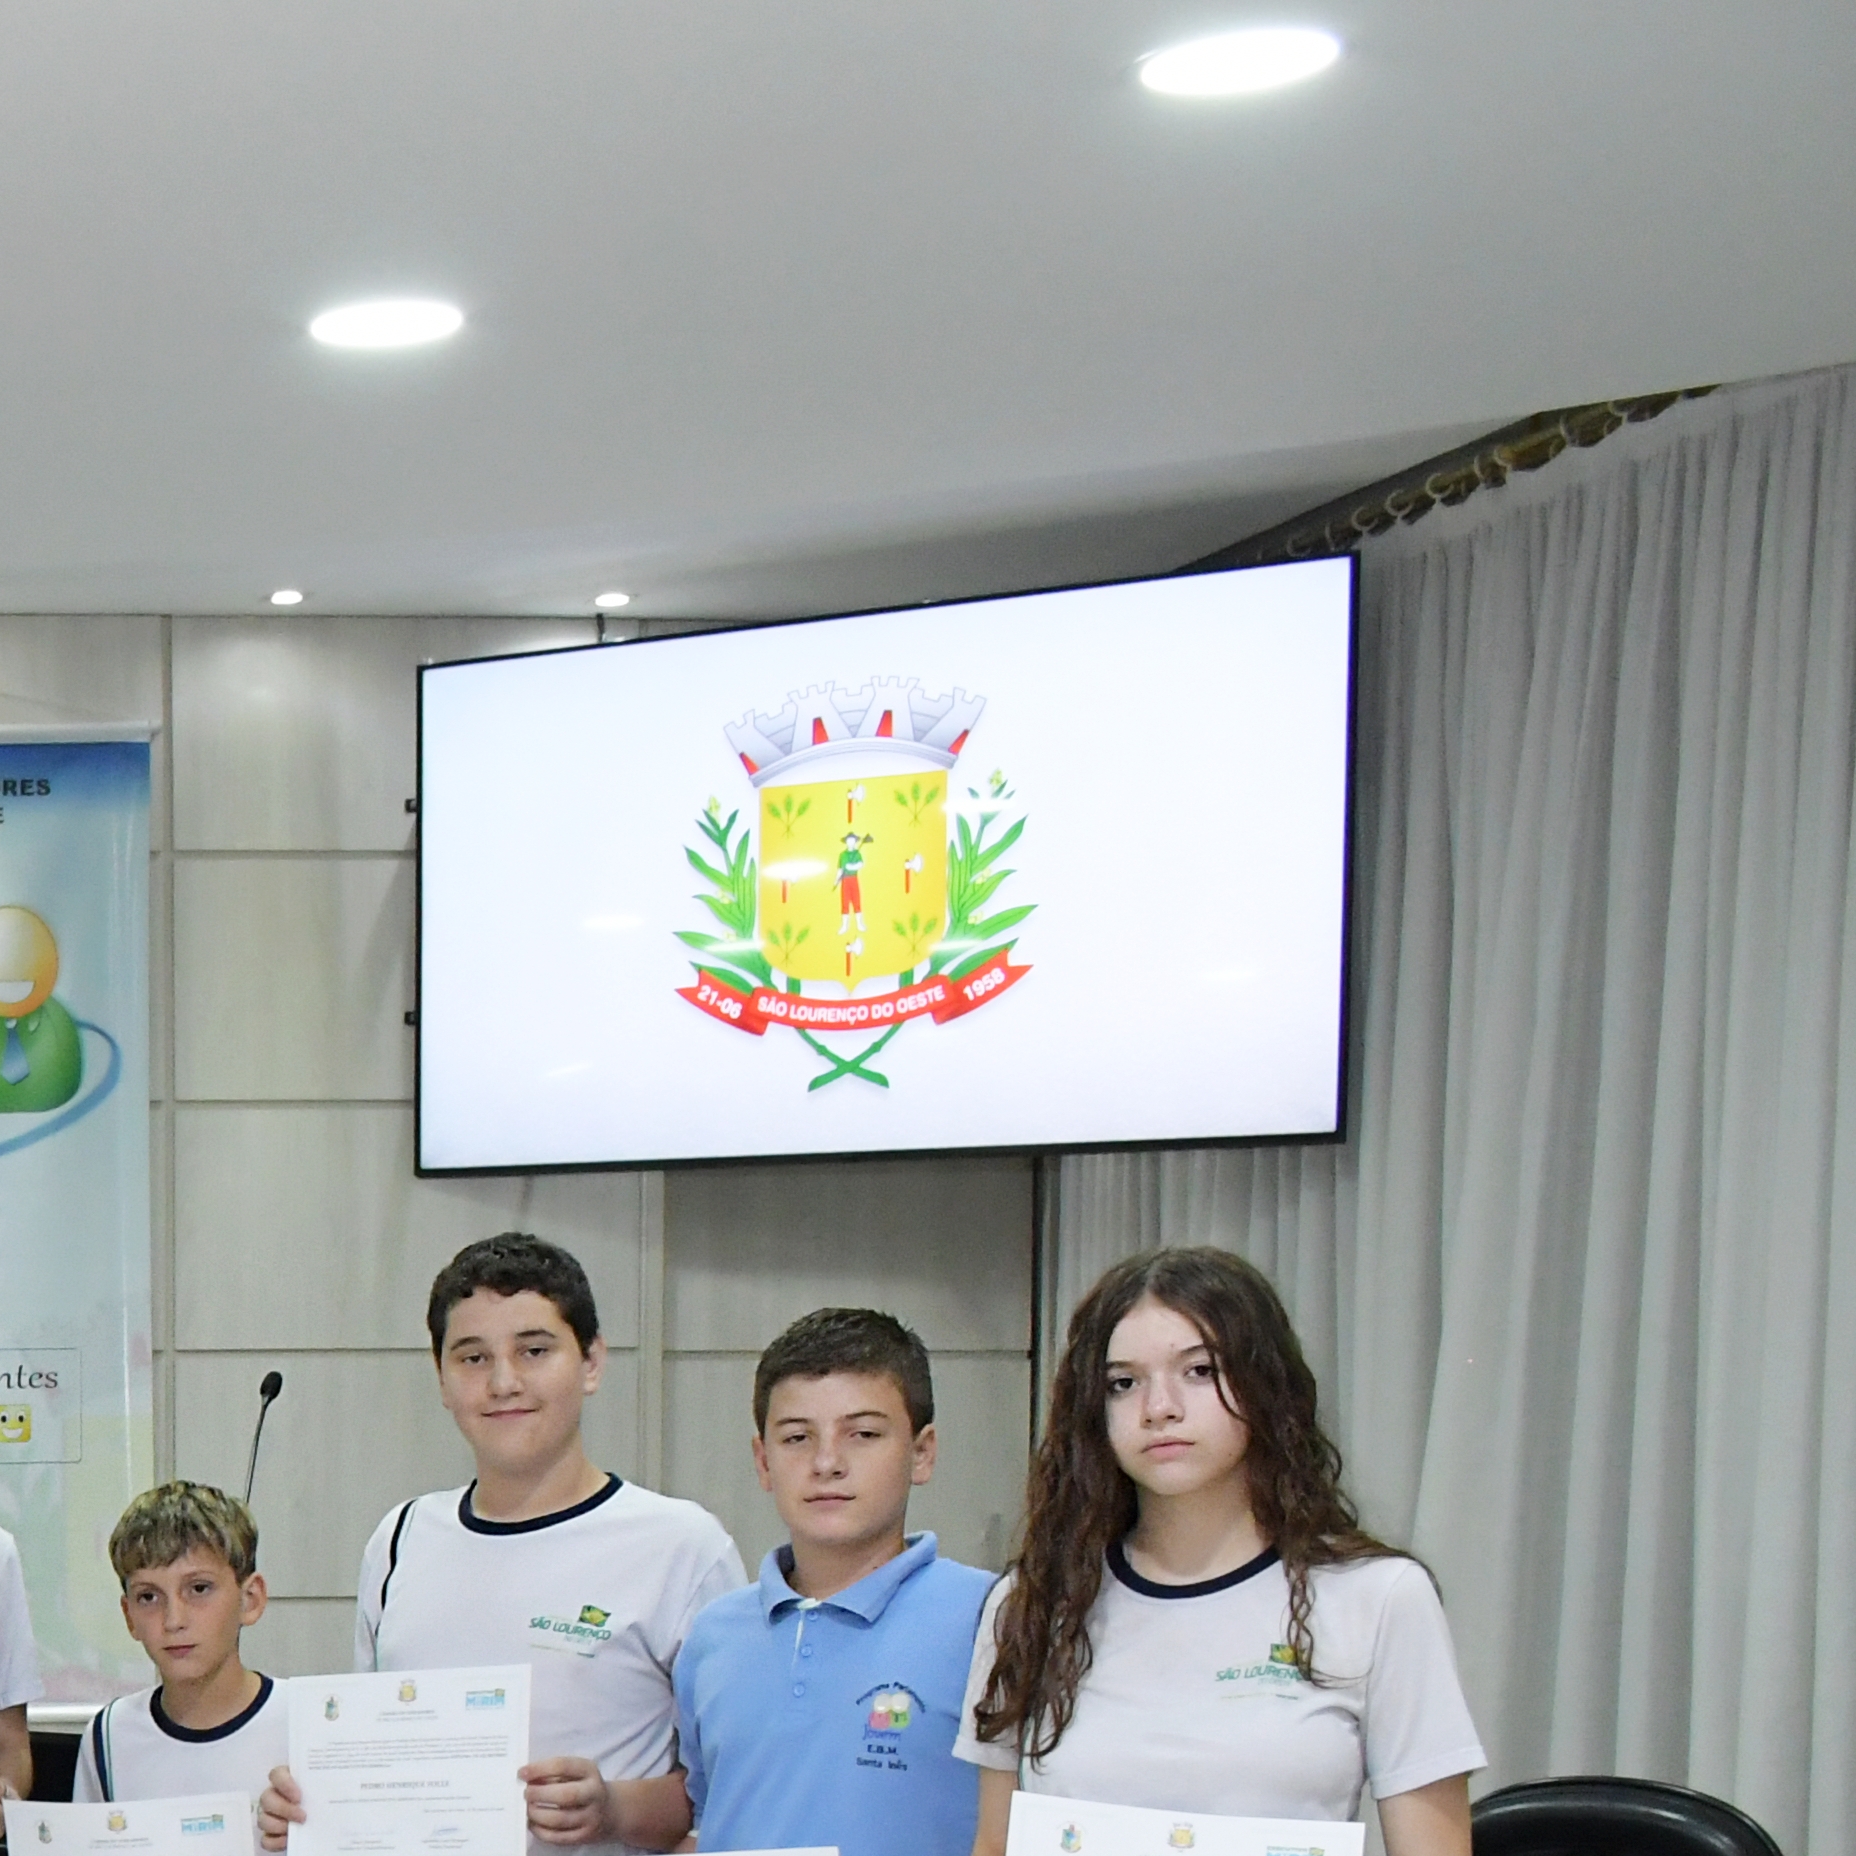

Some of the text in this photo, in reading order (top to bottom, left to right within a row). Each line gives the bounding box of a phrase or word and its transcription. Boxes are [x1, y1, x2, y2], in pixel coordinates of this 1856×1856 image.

[962, 967, 1006, 1001] 1958
[696, 983, 743, 1020] 21-06
[758, 985, 946, 1026] SÃO LOURENÇO DO OESTE
[529, 1617, 611, 1641] SÃO LOURENÇO
[1215, 1667, 1240, 1681] SÃO
